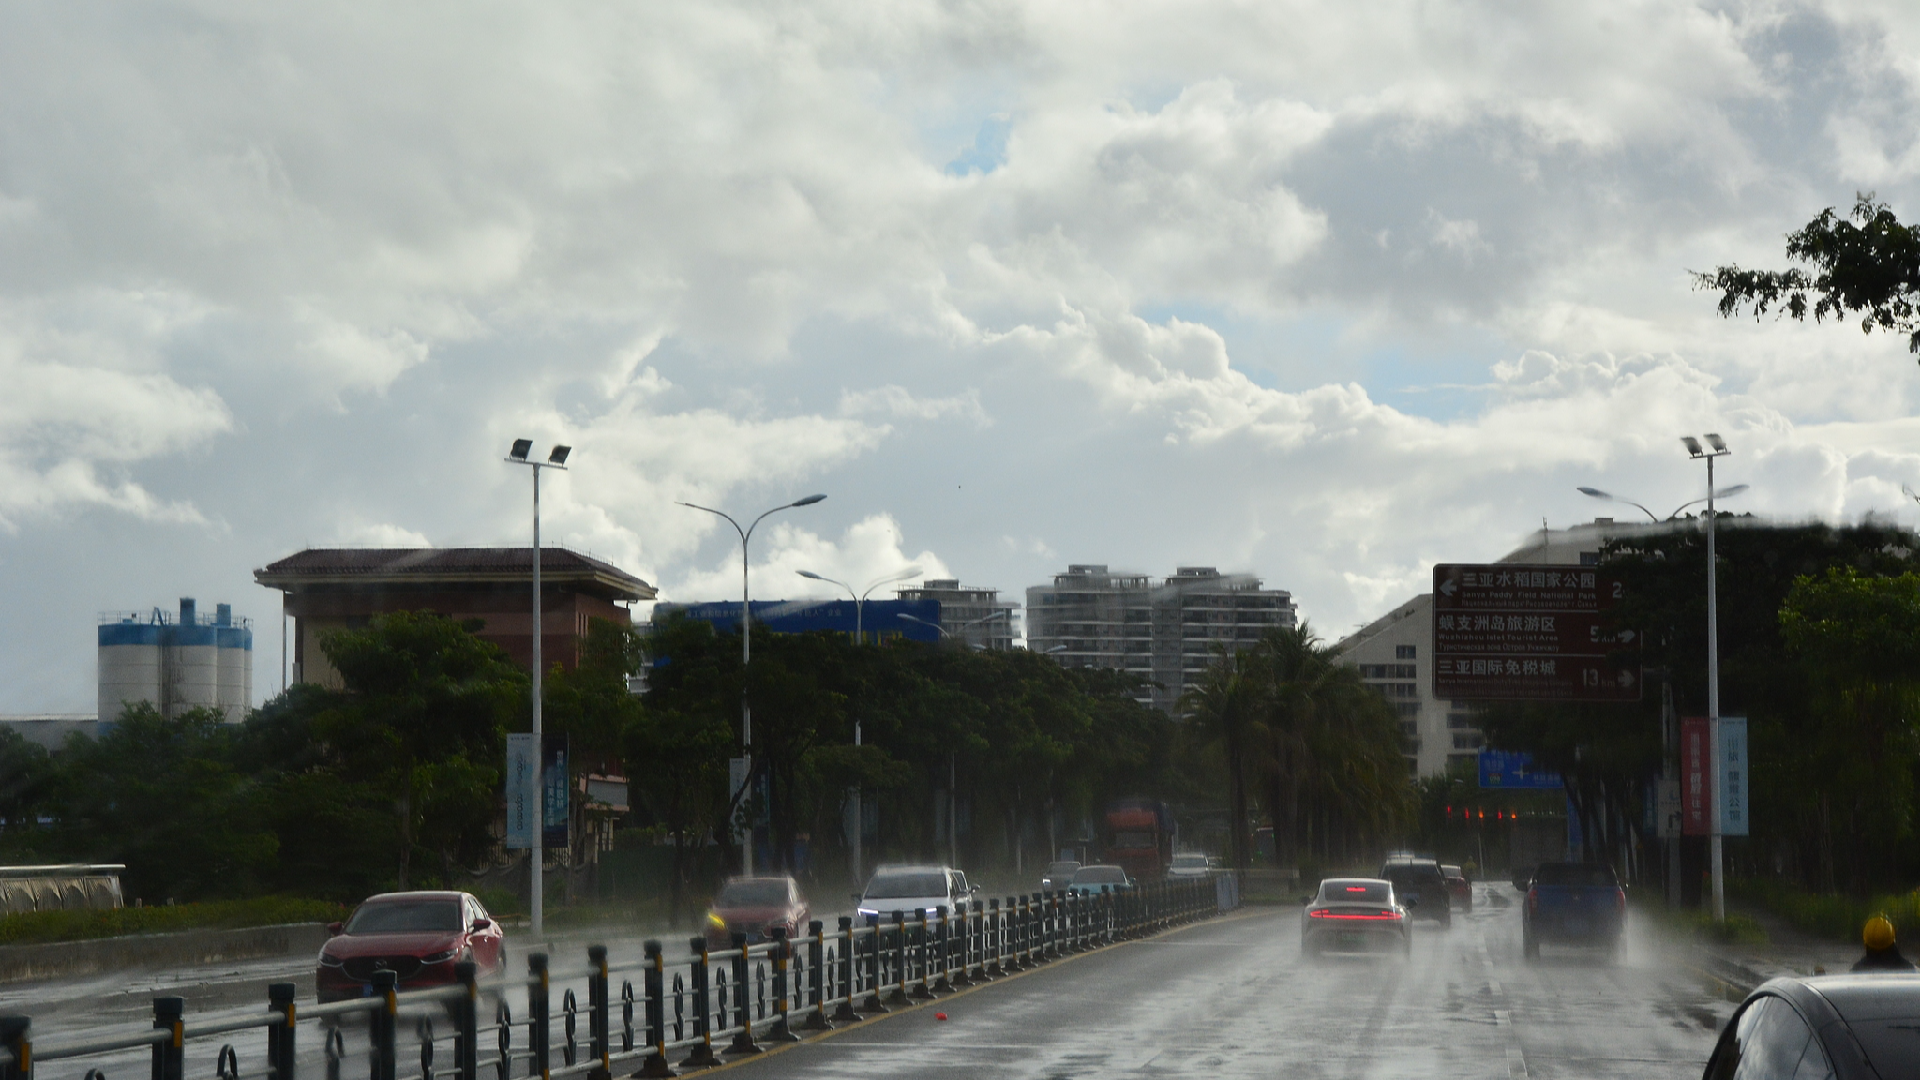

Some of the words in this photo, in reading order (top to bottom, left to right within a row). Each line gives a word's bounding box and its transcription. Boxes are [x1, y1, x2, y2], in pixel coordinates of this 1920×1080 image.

[1462, 571, 1596, 589] 三亚水稻国家公园
[1461, 591, 1486, 600] Sanya
[1489, 592, 1513, 600] Paddy
[1540, 592, 1574, 600] National
[1578, 592, 1597, 600] Park
[1438, 615, 1556, 632] 蜈支洲岛旅游区
[1438, 633, 1484, 641] Wuzhizhou
[1438, 659, 1556, 676] 三亚国际免税城
[1582, 668, 1599, 686] 13
